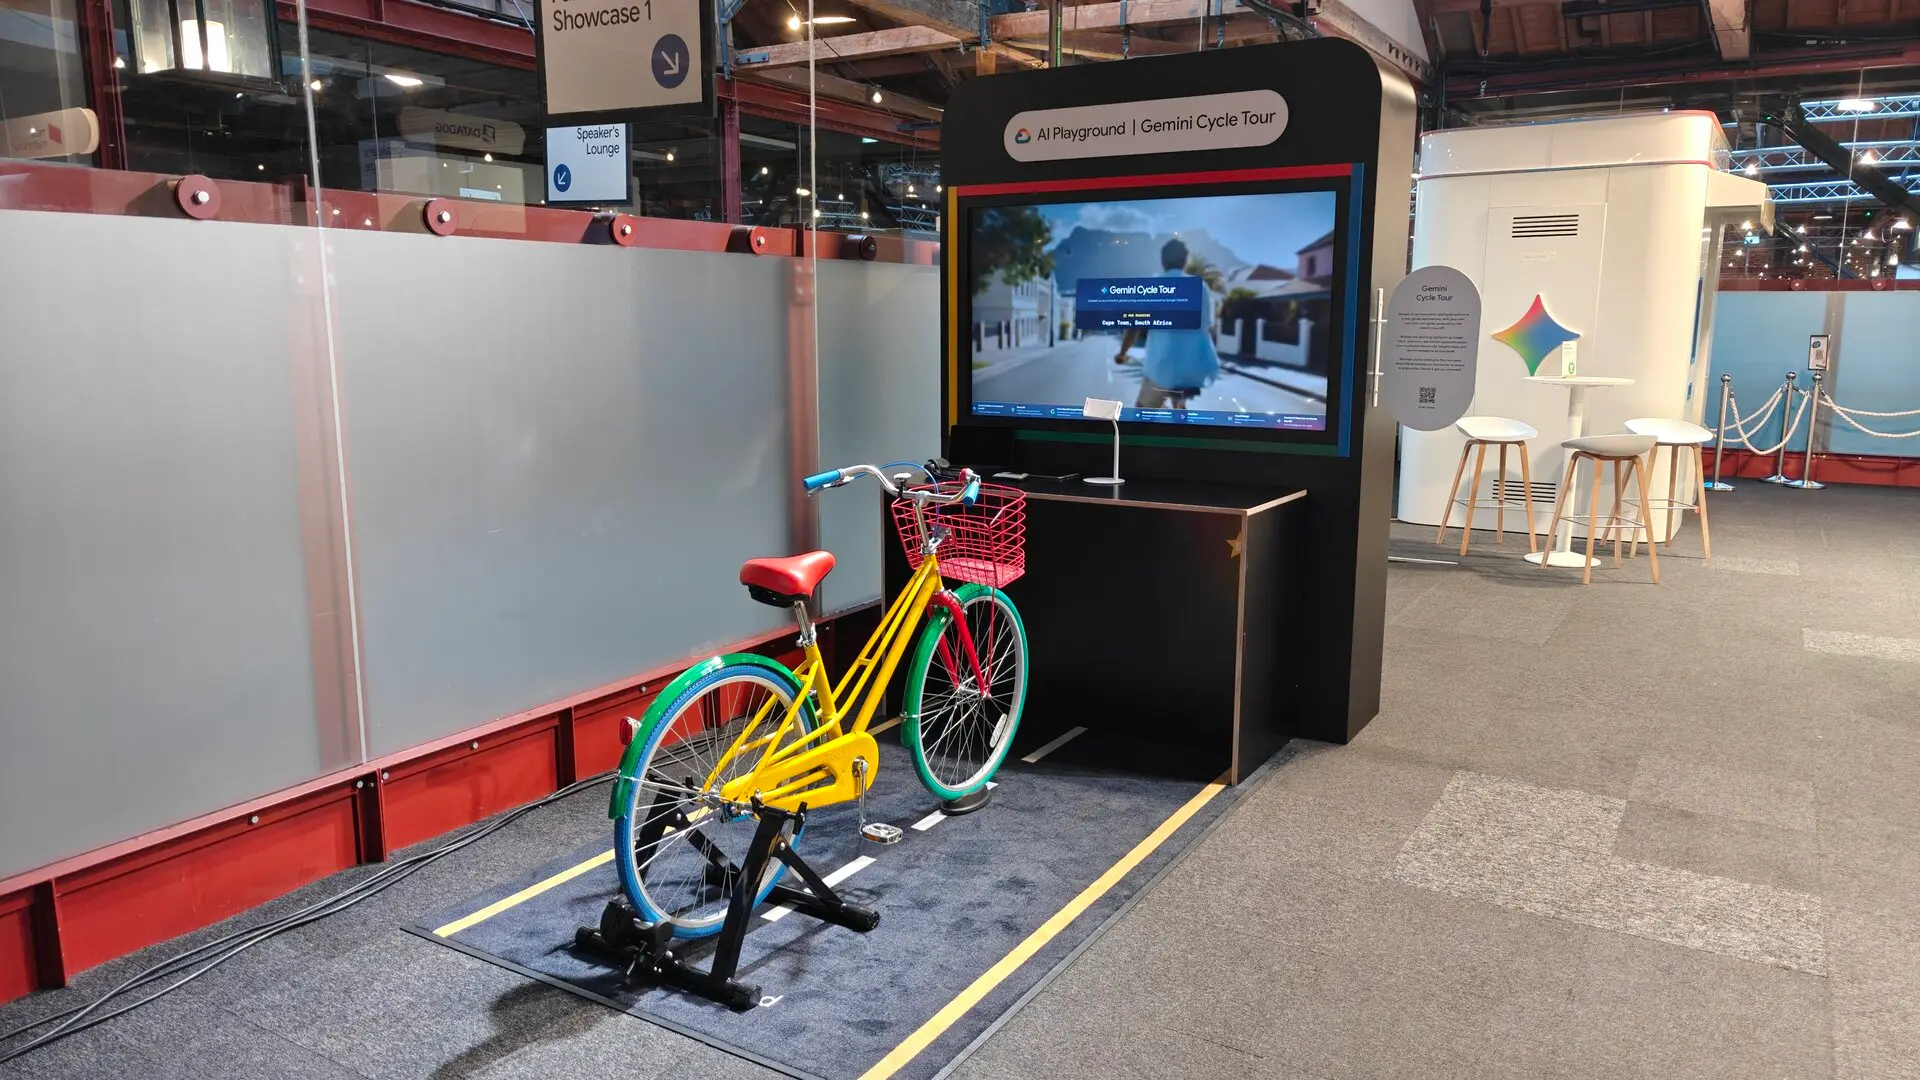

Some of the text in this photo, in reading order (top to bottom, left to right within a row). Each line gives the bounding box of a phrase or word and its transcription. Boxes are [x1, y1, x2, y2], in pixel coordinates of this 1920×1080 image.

[553, 0, 652, 32] Showcase 1
[576, 126, 620, 142] Speaker's
[1037, 127, 1050, 142] AI
[1053, 121, 1126, 143] Playground
[1140, 115, 1193, 134] Gemini
[1196, 112, 1239, 135] Cycle
[1241, 110, 1276, 126] Tour
[586, 143, 620, 157] Lounge
[1109, 285, 1176, 296] Gemini Cycle Tour
[1416, 294, 1436, 302] Cycle
